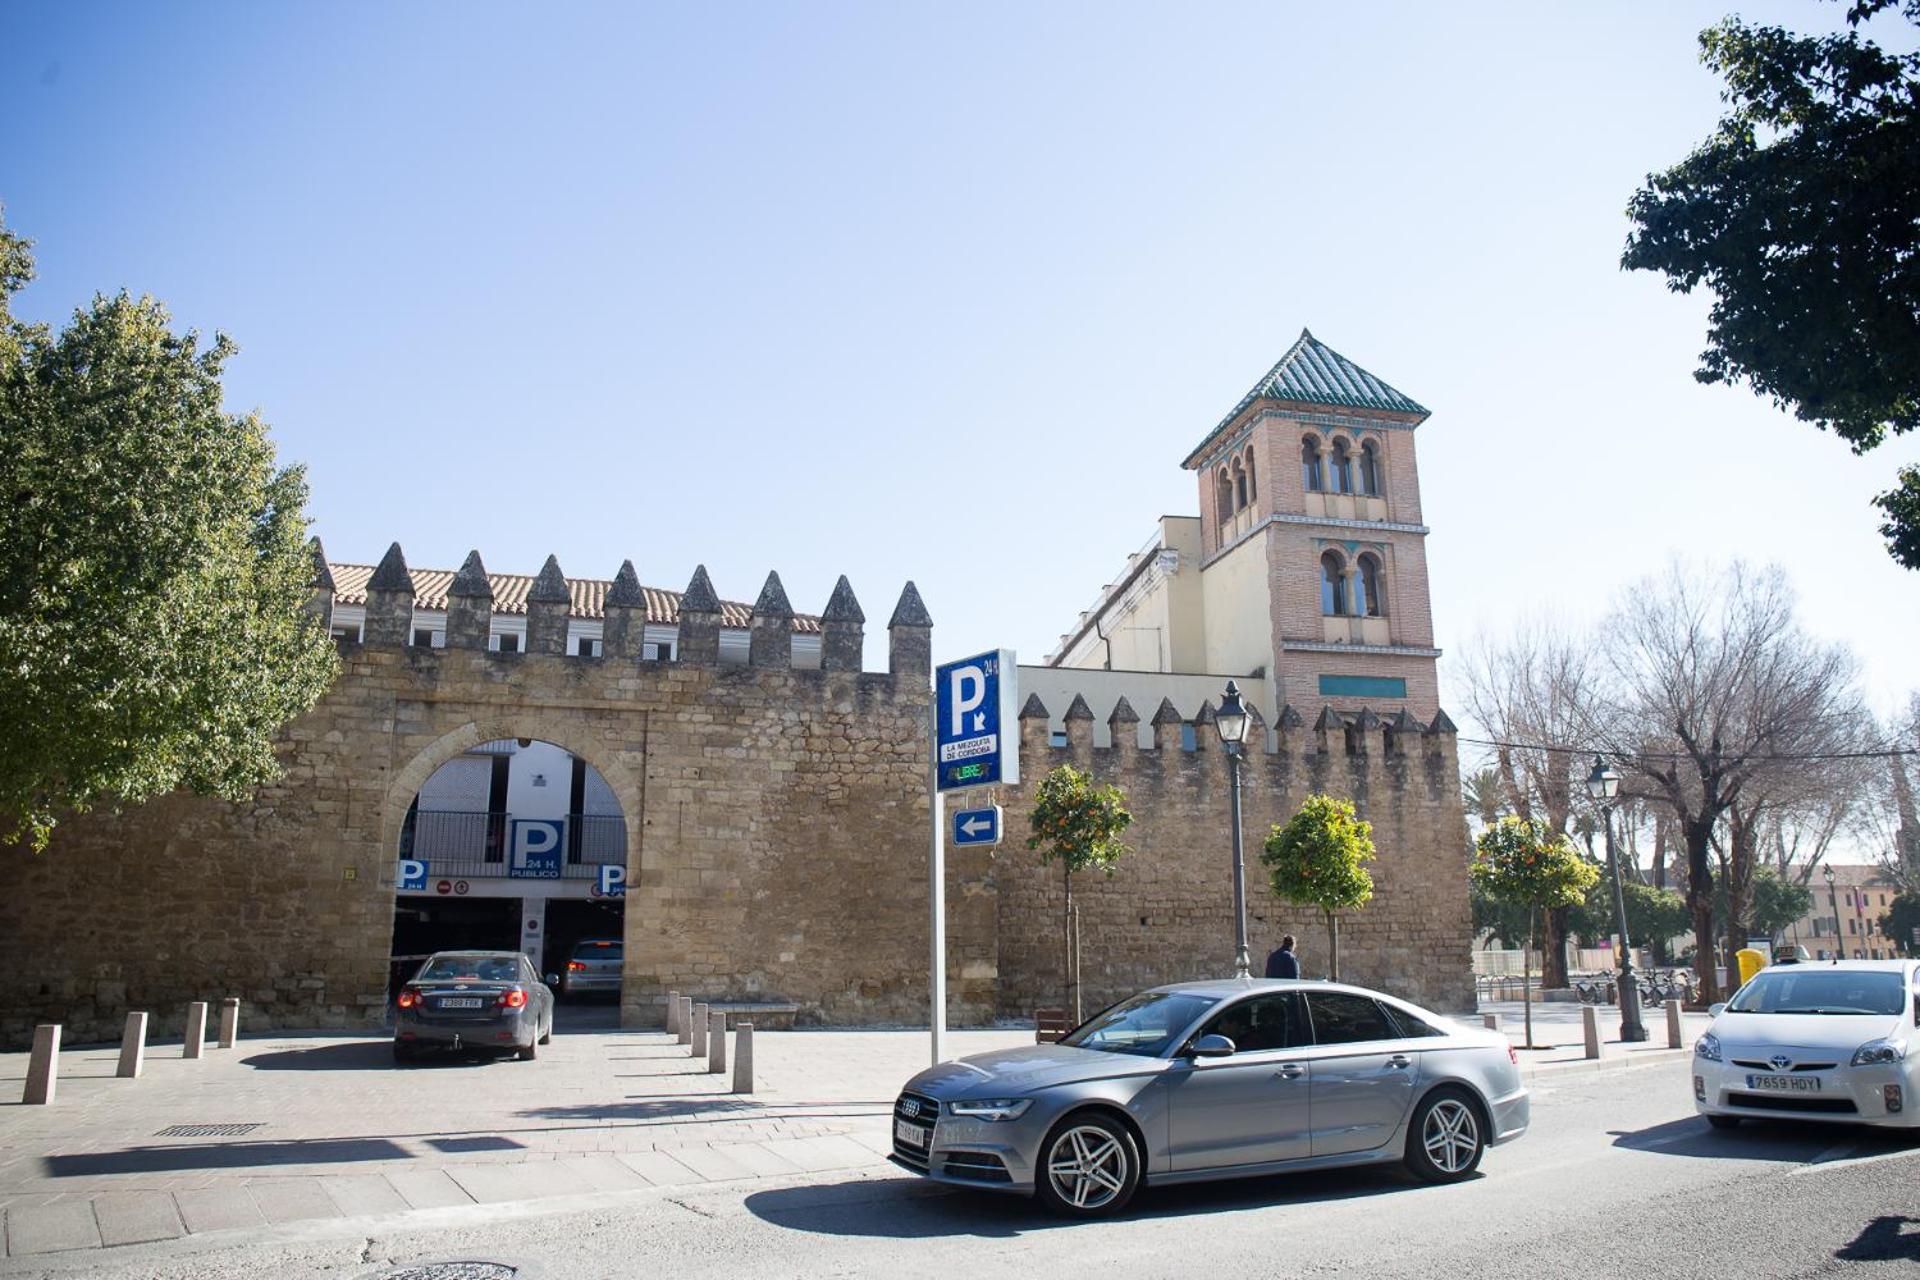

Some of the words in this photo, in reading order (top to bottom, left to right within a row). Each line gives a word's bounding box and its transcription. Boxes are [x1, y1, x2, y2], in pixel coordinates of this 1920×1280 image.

[984, 659, 992, 677] 24
[951, 665, 985, 736] P
[946, 744, 956, 752] LA
[957, 737, 990, 750] MEZQUITA
[946, 752, 956, 760] DE
[956, 763, 983, 779] LIBRE
[514, 821, 558, 868] P
[527, 860, 541, 868] 24
[396, 860, 424, 888] P
[511, 869, 559, 878] PUBLICO
[602, 865, 627, 893] P
[1755, 1077, 1788, 1089] 7659
[1790, 1077, 1814, 1090] HDY
